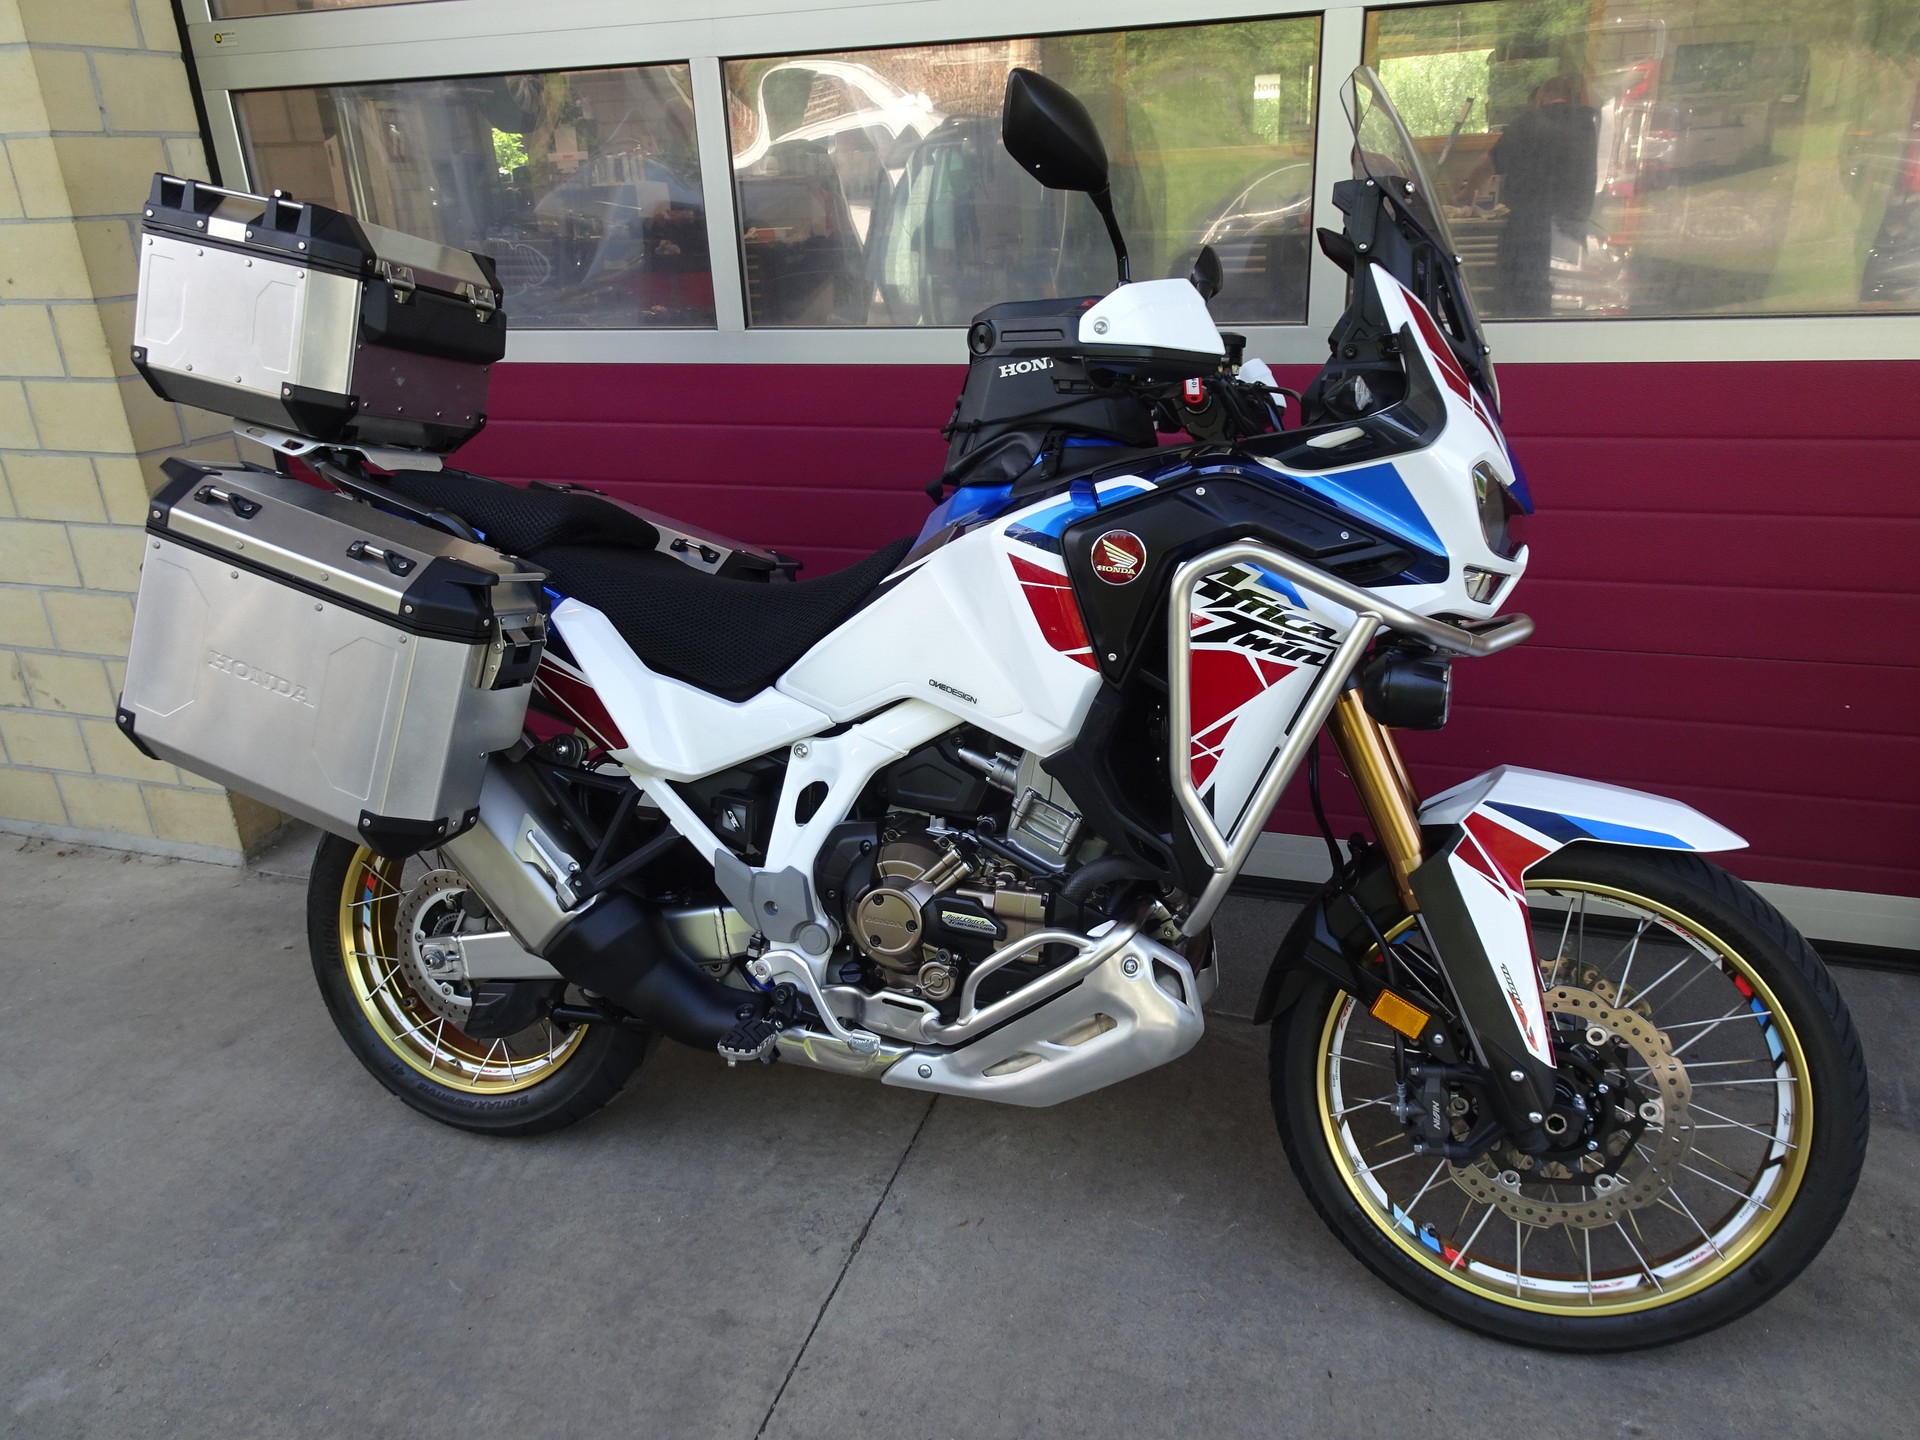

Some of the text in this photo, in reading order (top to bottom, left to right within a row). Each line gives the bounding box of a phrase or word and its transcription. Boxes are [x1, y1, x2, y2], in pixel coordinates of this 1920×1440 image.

[999, 357, 1054, 377] HON
[1096, 564, 1136, 575] HONDA
[1191, 611, 1337, 667] Twin
[208, 649, 315, 708] HONDA
[928, 679, 978, 704] ONEDESIGN
[946, 913, 986, 925] Dual Clutch
[948, 919, 995, 932] Transmission
